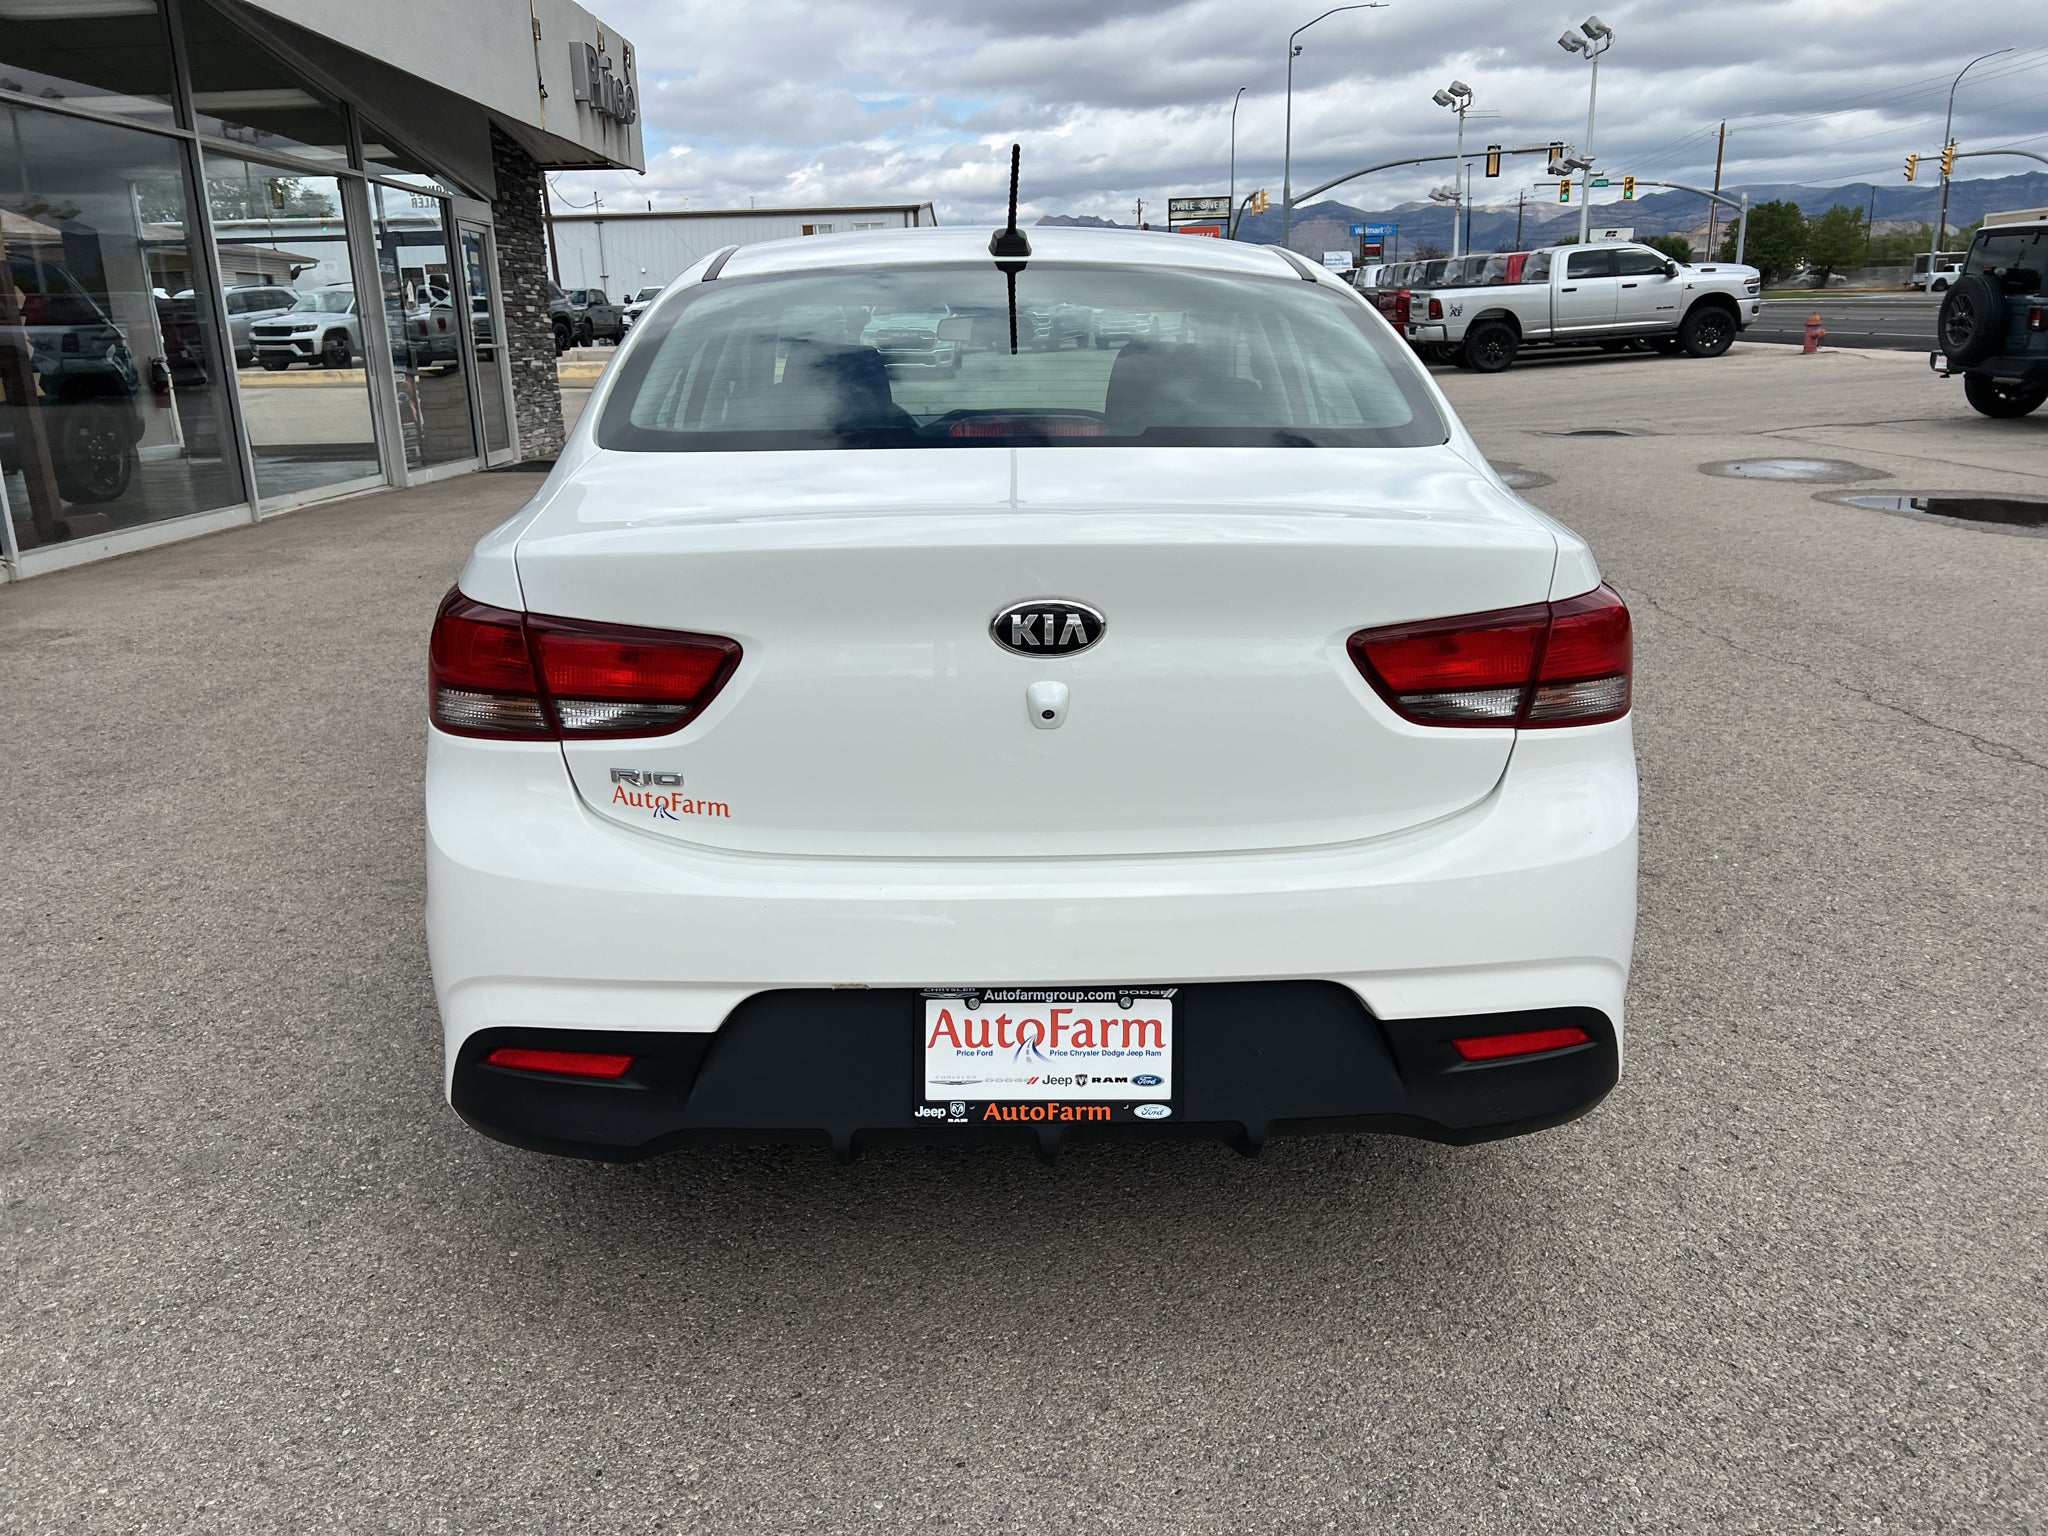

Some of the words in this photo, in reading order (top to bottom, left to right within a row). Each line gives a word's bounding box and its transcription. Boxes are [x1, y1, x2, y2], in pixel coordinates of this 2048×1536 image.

[569, 42, 636, 124] Price
[1170, 202, 1195, 210] CYCLE
[1199, 200, 1229, 209] SAVERS
[1354, 226, 1384, 234] Walmart
[1010, 613, 1088, 645] KIA
[610, 767, 684, 787] RIO
[612, 785, 731, 818] AutoFarm
[984, 989, 1116, 1003] Autofarmgroup.com
[927, 1008, 1167, 1048] AutoFarm
[1069, 1050, 1100, 1058] Chrysler
[1101, 1050, 1125, 1058] Dodge
[1126, 1050, 1143, 1058] Jeep
[1042, 1074, 1073, 1087] Jeep
[1137, 1076, 1157, 1085] Ford
[914, 1106, 947, 1119] Jeep
[983, 1102, 1111, 1121] AutoFarm
[1141, 1106, 1164, 1116] Ford
